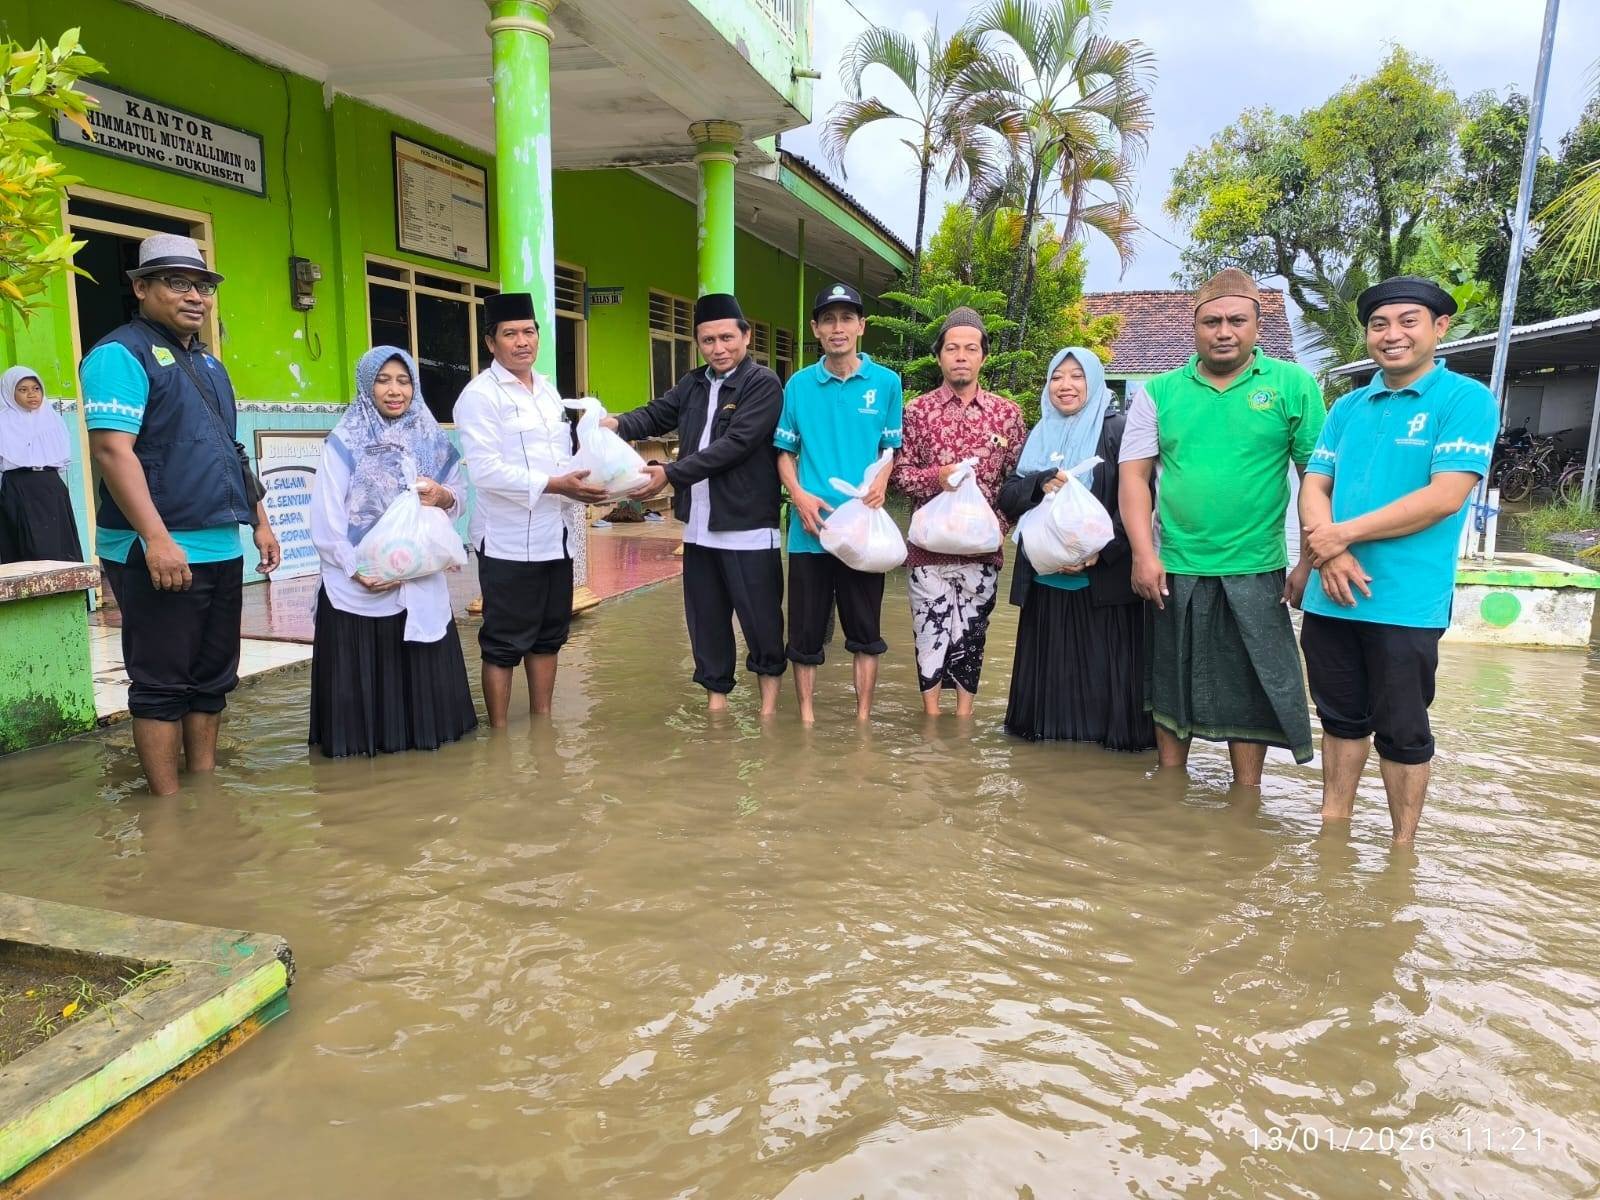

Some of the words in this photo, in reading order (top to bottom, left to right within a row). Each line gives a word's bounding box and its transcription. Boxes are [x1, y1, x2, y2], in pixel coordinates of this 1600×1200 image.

[125, 100, 214, 141] KANTOR
[160, 130, 242, 168] MUTA'ALLIMIN
[244, 158, 256, 173] 03
[175, 154, 245, 184] DUKUHSETI
[274, 476, 306, 490] SALAM
[279, 512, 304, 525] SAPA
